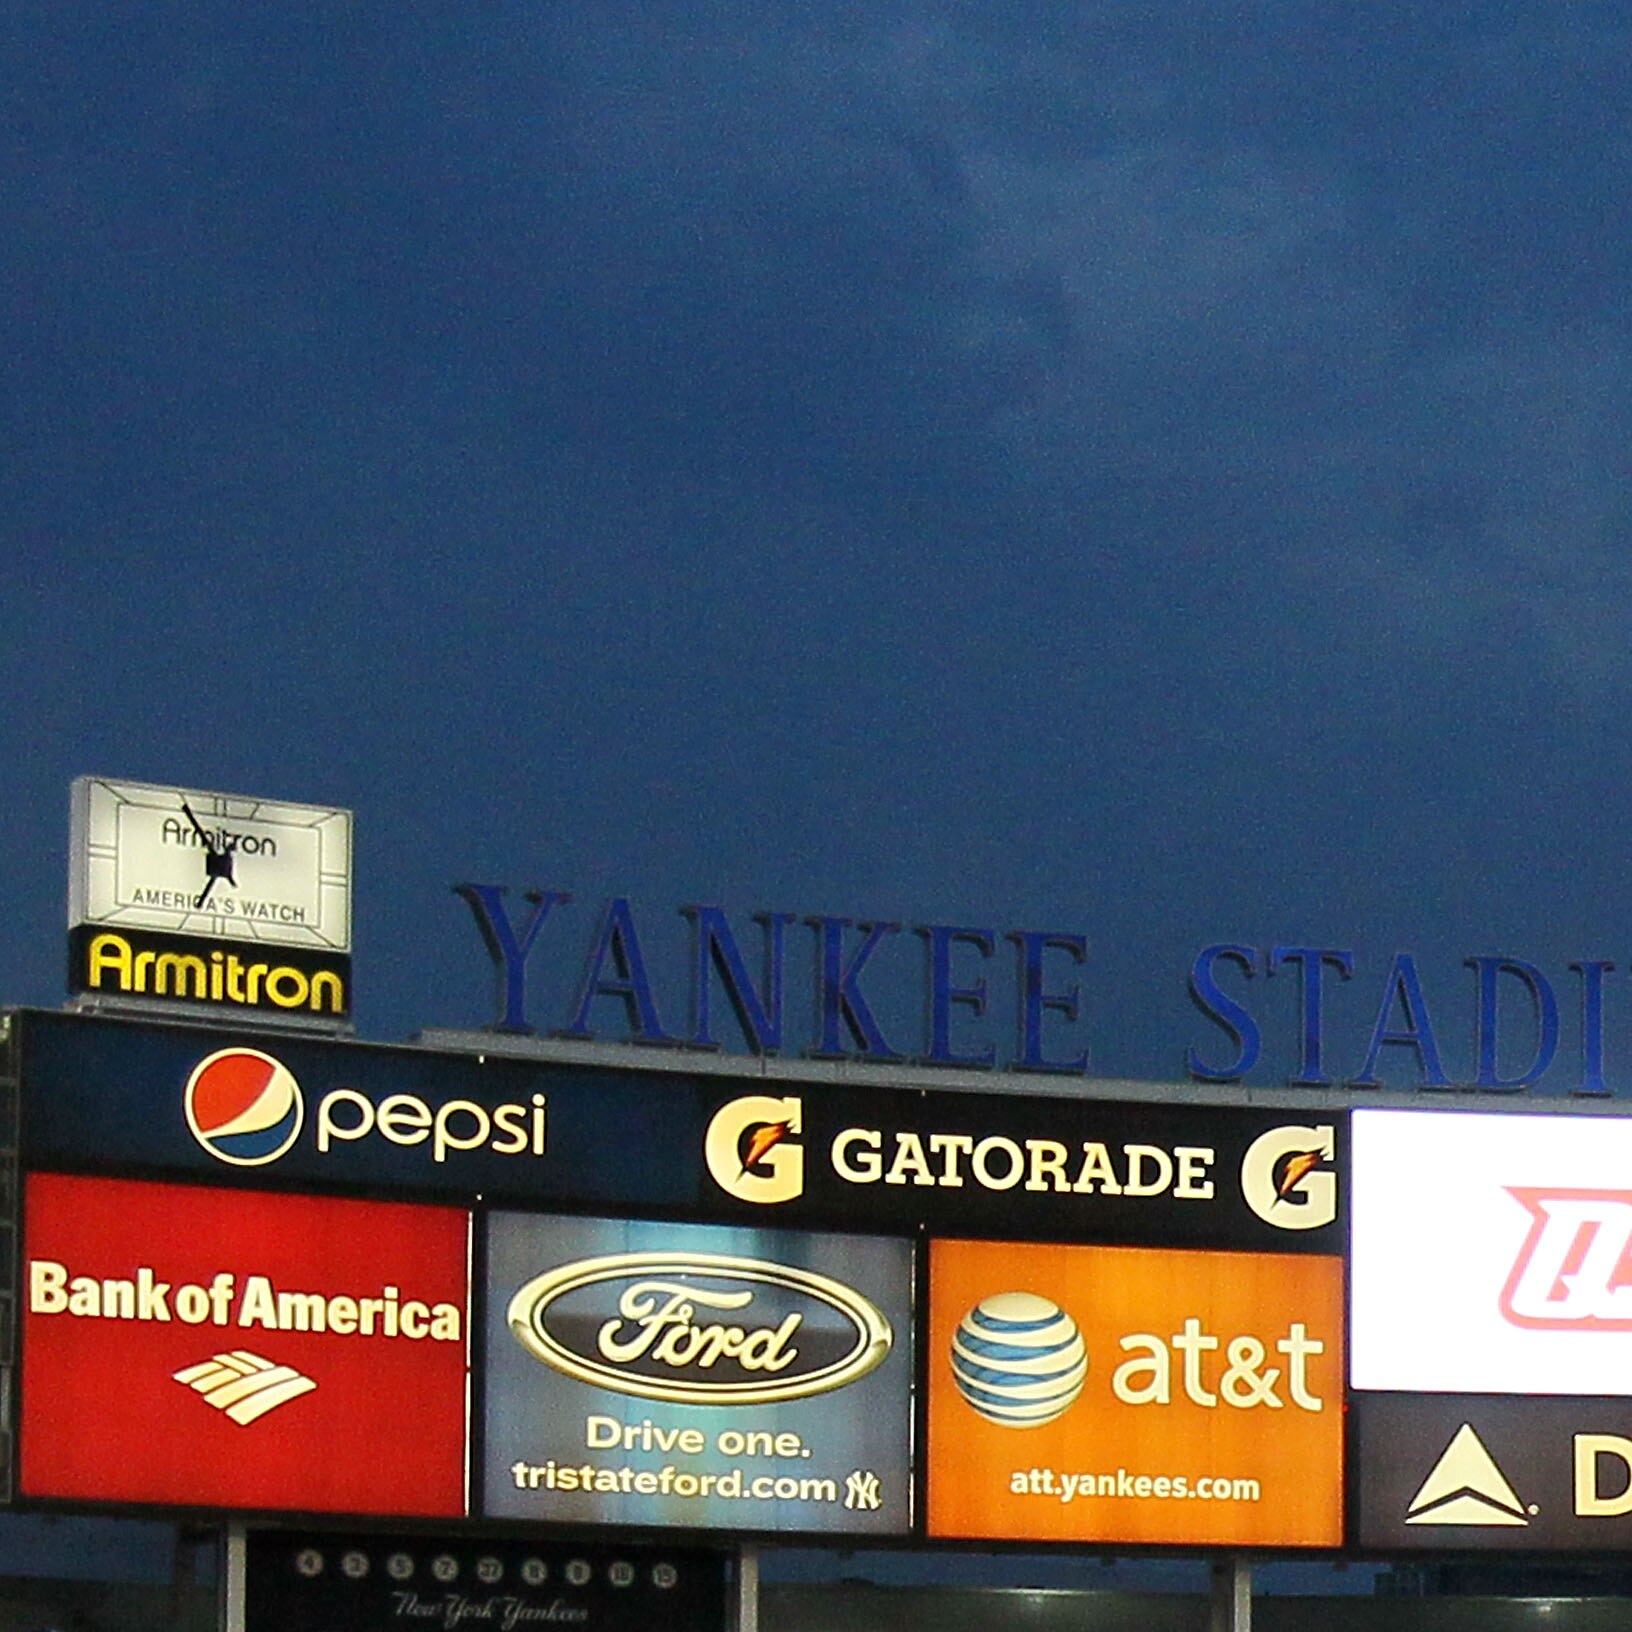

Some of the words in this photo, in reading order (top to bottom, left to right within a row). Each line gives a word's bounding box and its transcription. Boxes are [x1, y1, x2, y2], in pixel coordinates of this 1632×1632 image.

[162, 818, 276, 857] Armitron
[133, 889, 235, 914] AMERICA'S
[241, 900, 304, 923] WATCH
[88, 934, 345, 1013] Armitron
[453, 883, 1090, 1073] YANKEE
[318, 1090, 546, 1161] pepsi
[705, 1096, 802, 1203] G
[831, 1128, 1214, 1198] GATORADE
[1241, 1126, 1336, 1229] G
[29, 1260, 171, 1320] Bank
[176, 1274, 234, 1326] of
[239, 1276, 461, 1340] America
[599, 1281, 802, 1372] Ford
[1113, 1318, 1324, 1412] at&t
[586, 1415, 706, 1458] Drive
[718, 1423, 811, 1459] one.
[512, 1461, 836, 1503] tristateford.com
[1010, 1469, 1260, 1503] att.yankees.com
[444, 1594, 493, 1629] York
[501, 1596, 588, 1631] Yankees
